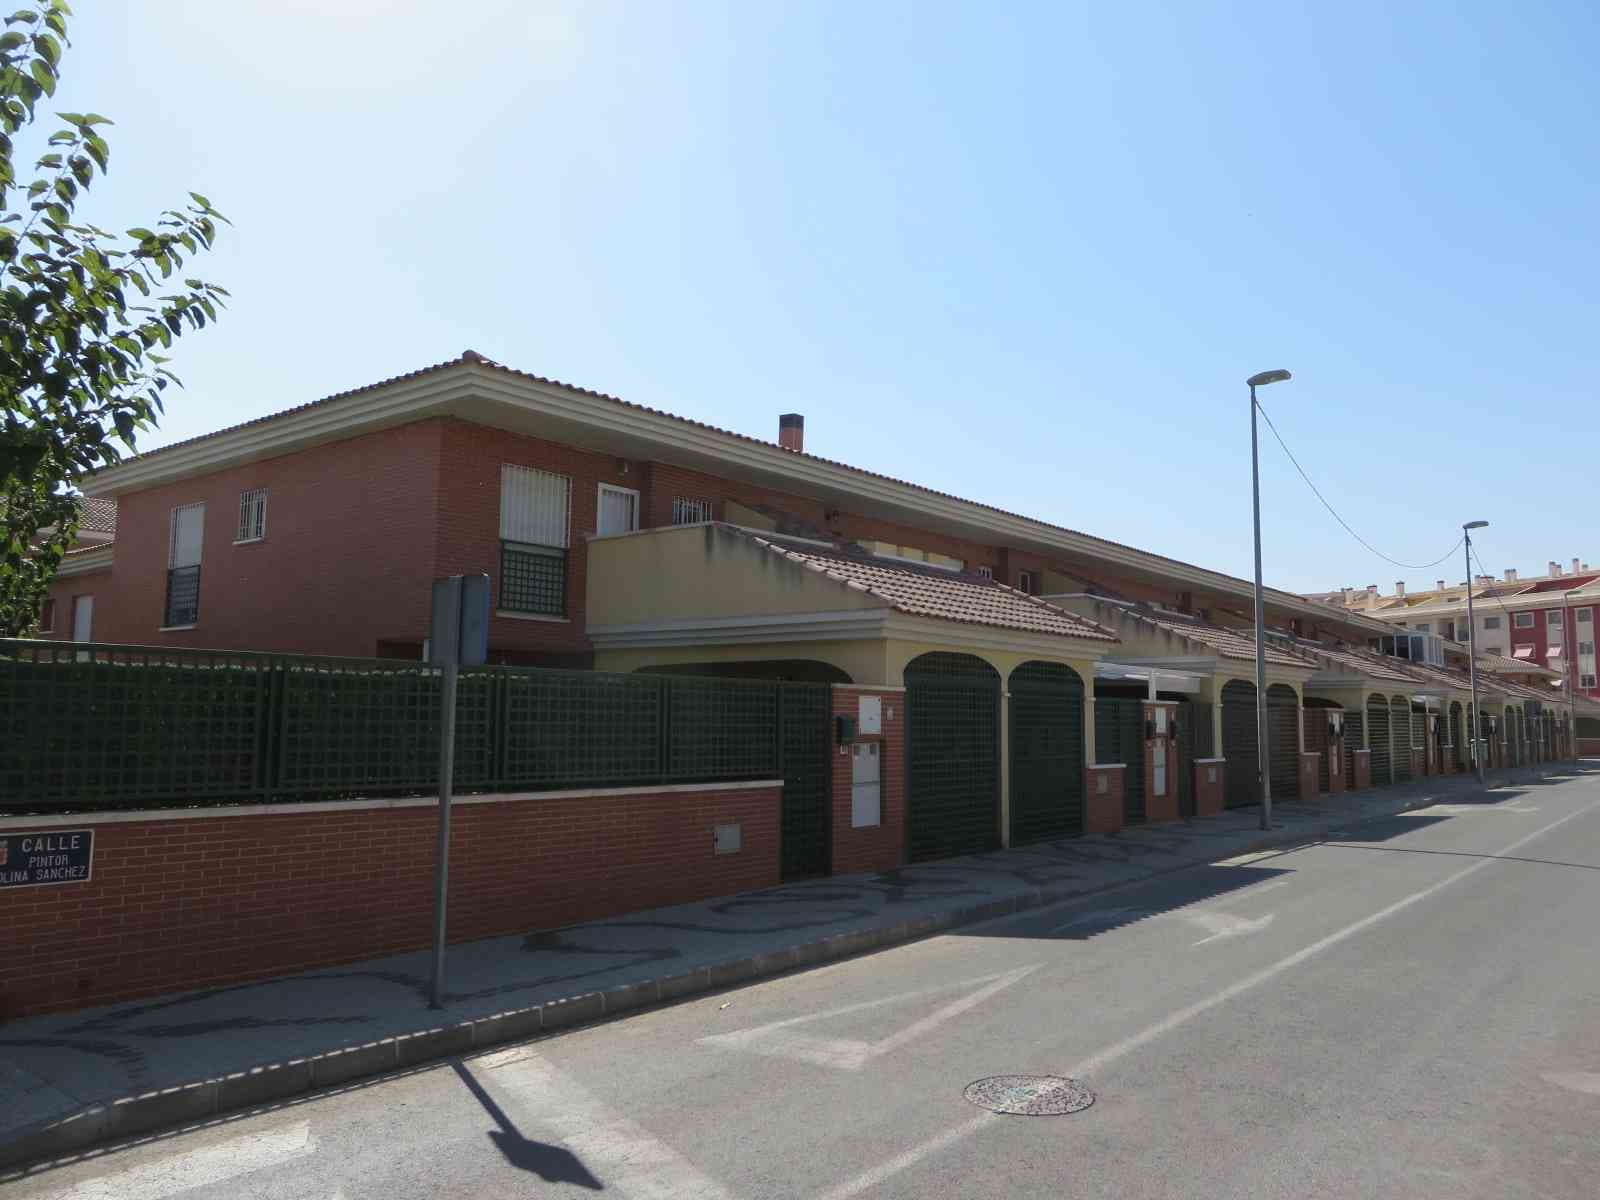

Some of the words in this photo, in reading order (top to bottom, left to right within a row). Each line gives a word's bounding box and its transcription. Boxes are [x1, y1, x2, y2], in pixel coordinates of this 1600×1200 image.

[22, 835, 81, 853] CALLE
[28, 855, 68, 868] PINTOR
[36, 866, 86, 880] SANCHEZ
